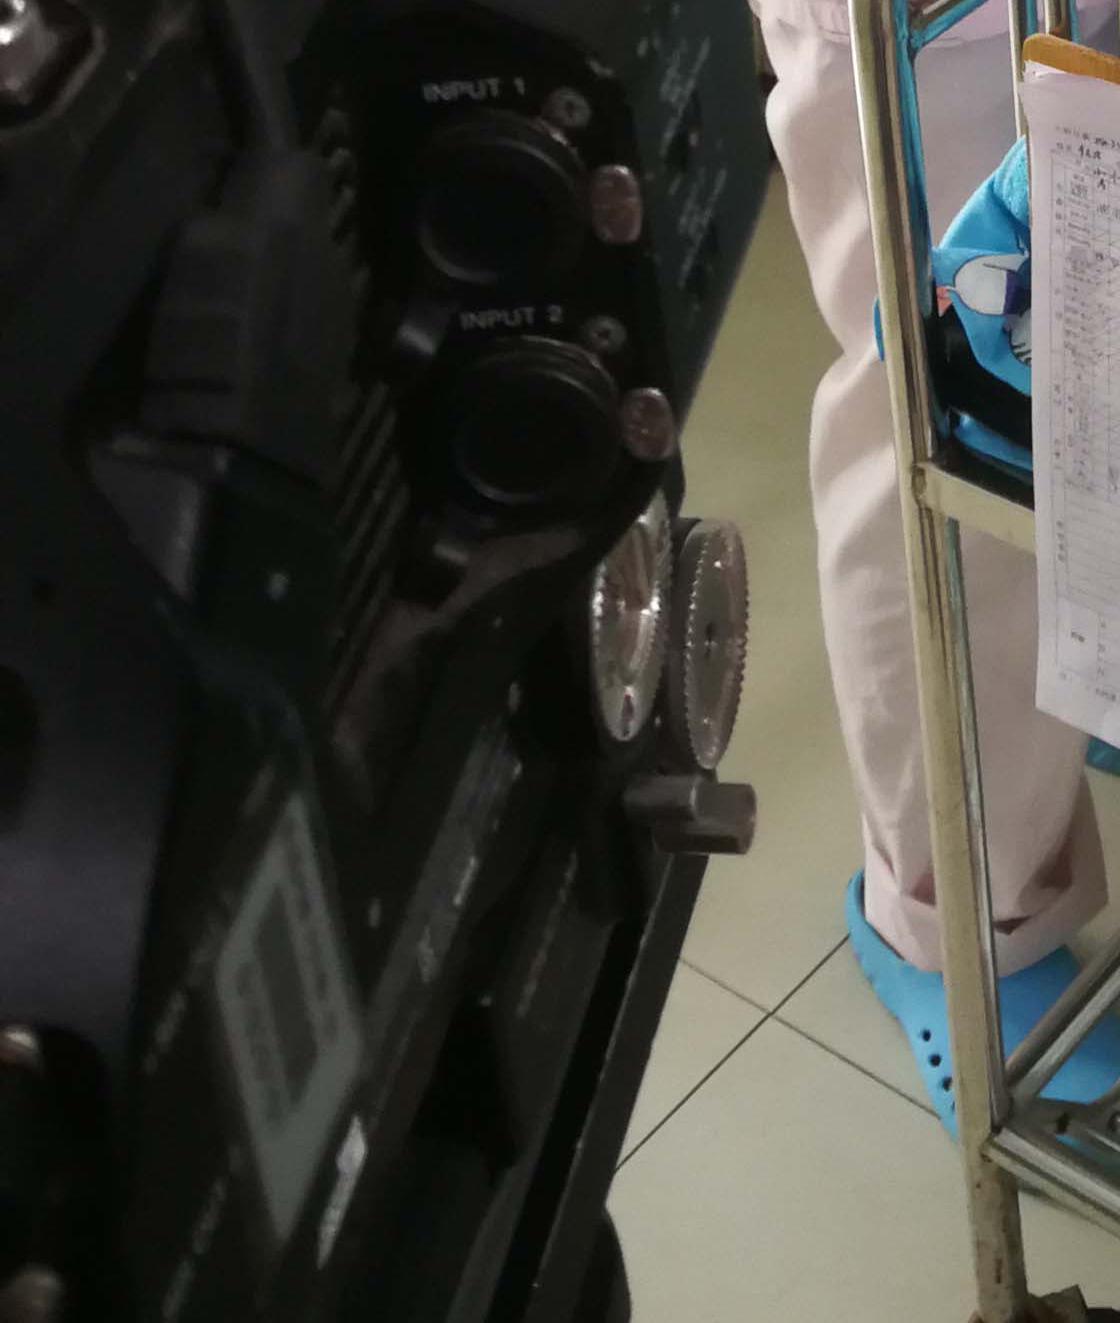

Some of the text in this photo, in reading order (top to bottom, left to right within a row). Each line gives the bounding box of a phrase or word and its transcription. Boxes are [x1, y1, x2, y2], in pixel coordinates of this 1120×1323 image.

[423, 76, 526, 102] INPUT 1
[460, 304, 562, 331] INPUT 2
